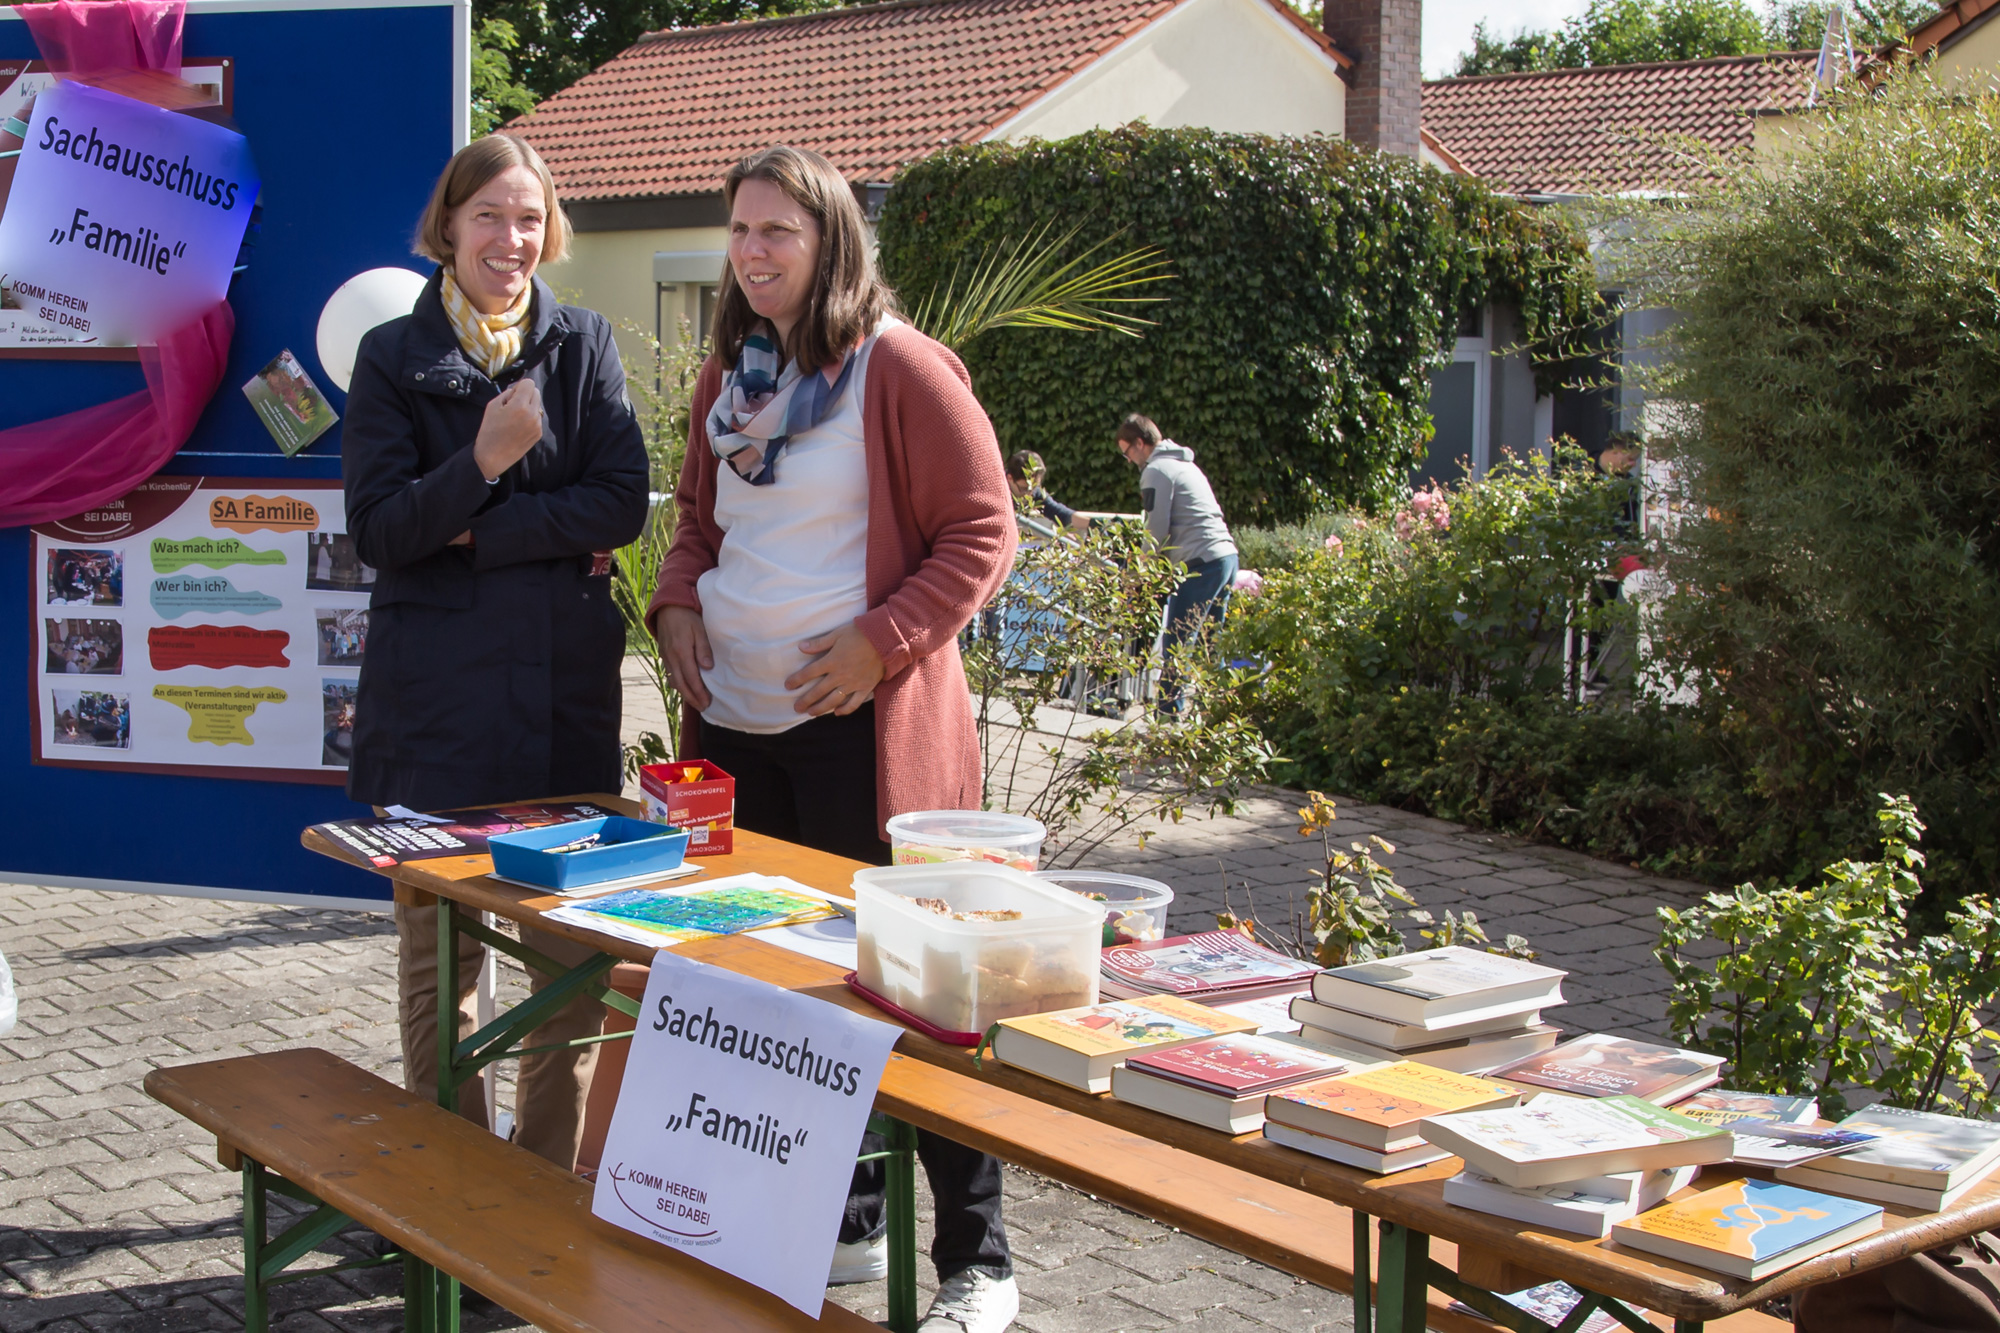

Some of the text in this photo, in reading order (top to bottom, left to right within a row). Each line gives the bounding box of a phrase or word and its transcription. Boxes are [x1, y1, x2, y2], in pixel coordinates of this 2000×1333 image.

[39, 116, 239, 211] Sachausschuss
[49, 207, 187, 276] „Familie“
[13, 280, 89, 313] KOMM HEREIN
[39, 306, 91, 333] SEI DABEI
[149, 483, 191, 491] Kirchentür
[84, 512, 132, 522] SEI DABEI
[213, 501, 315, 521] SA Familie
[153, 541, 240, 553] Was mach ich?
[155, 581, 228, 592] Wer bin ich?
[154, 688, 287, 700] An diesen Terminen sind wir aktiv
[184, 701, 256, 713] (Veranstaltungen)
[675, 787, 726, 797] SCHOKOWÜRFEL
[653, 995, 861, 1096] Sachausschuss
[1420, 1074, 1491, 1095] Dinge
[1540, 1069, 1572, 1079] von
[1575, 1075, 1622, 1089] Liebe
[1542, 1062, 1580, 1075] Eine
[1587, 1070, 1639, 1087] Vision
[665, 1092, 809, 1165] „Familie“
[628, 1169, 708, 1205] KOMM HEREIN
[656, 1197, 711, 1226] SEI DABEI
[1656, 1213, 1708, 1227] Gender
[1647, 1217, 1718, 1238] Revolution
